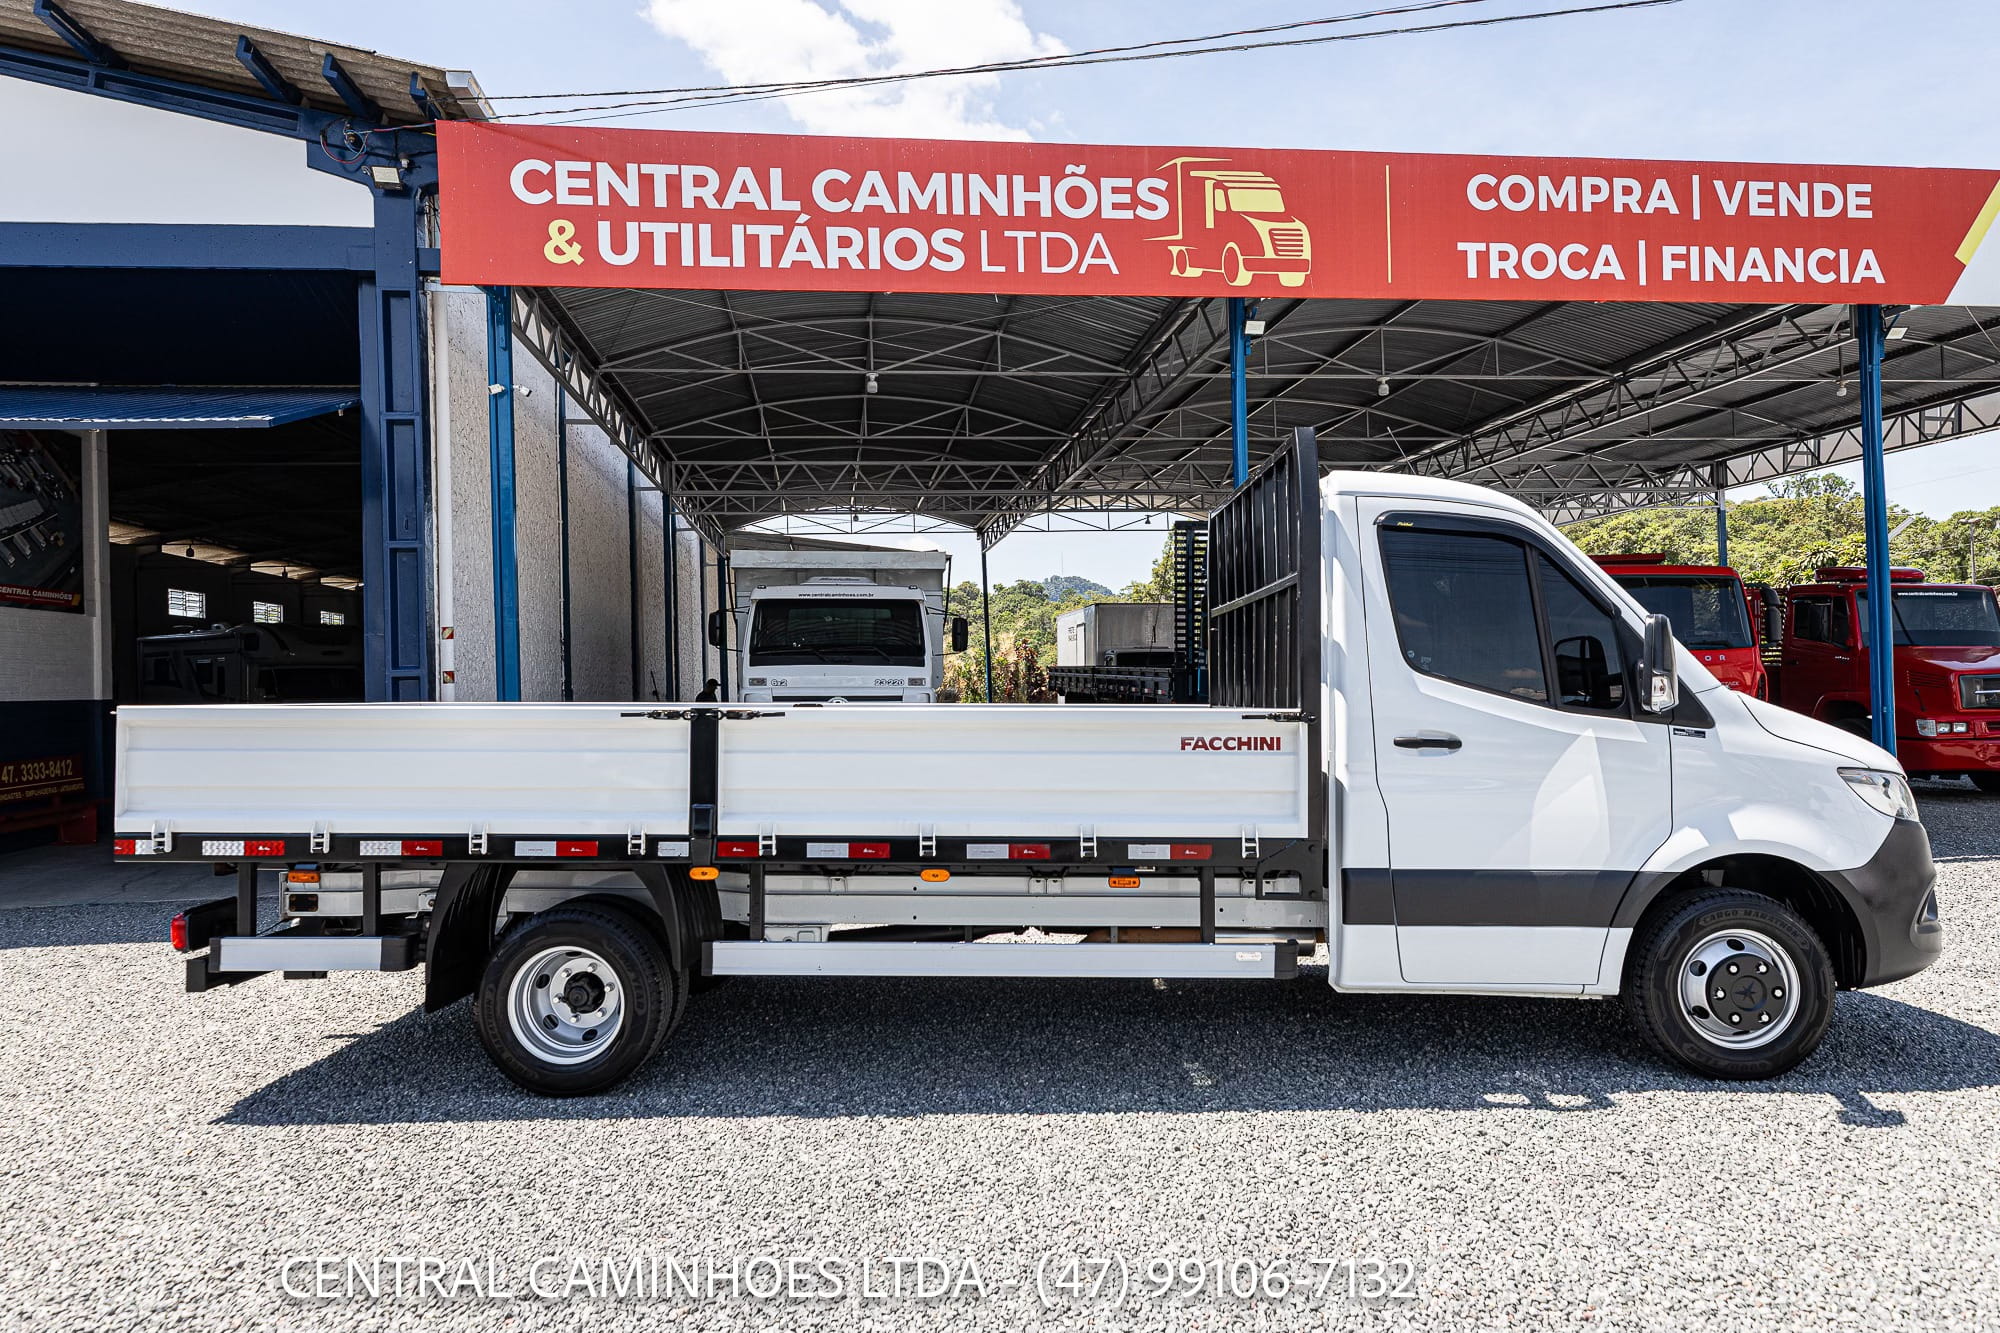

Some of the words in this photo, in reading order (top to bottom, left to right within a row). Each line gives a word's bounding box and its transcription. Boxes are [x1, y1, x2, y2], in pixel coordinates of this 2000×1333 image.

[510, 159, 801, 212] CENTRAL
[811, 164, 1169, 222] CAMINHÕES
[1467, 174, 1679, 215] COMPRA
[1714, 180, 1873, 219] VENDE
[543, 219, 584, 265] &
[597, 213, 965, 272] UTILITÁRIOS
[980, 230, 1120, 275] LTDA
[1457, 242, 1625, 281] TROCA
[1662, 245, 1886, 284] FINANCIA
[1180, 736, 1281, 751] FACCHINI
[21, 759, 73, 782] 3333-8412
